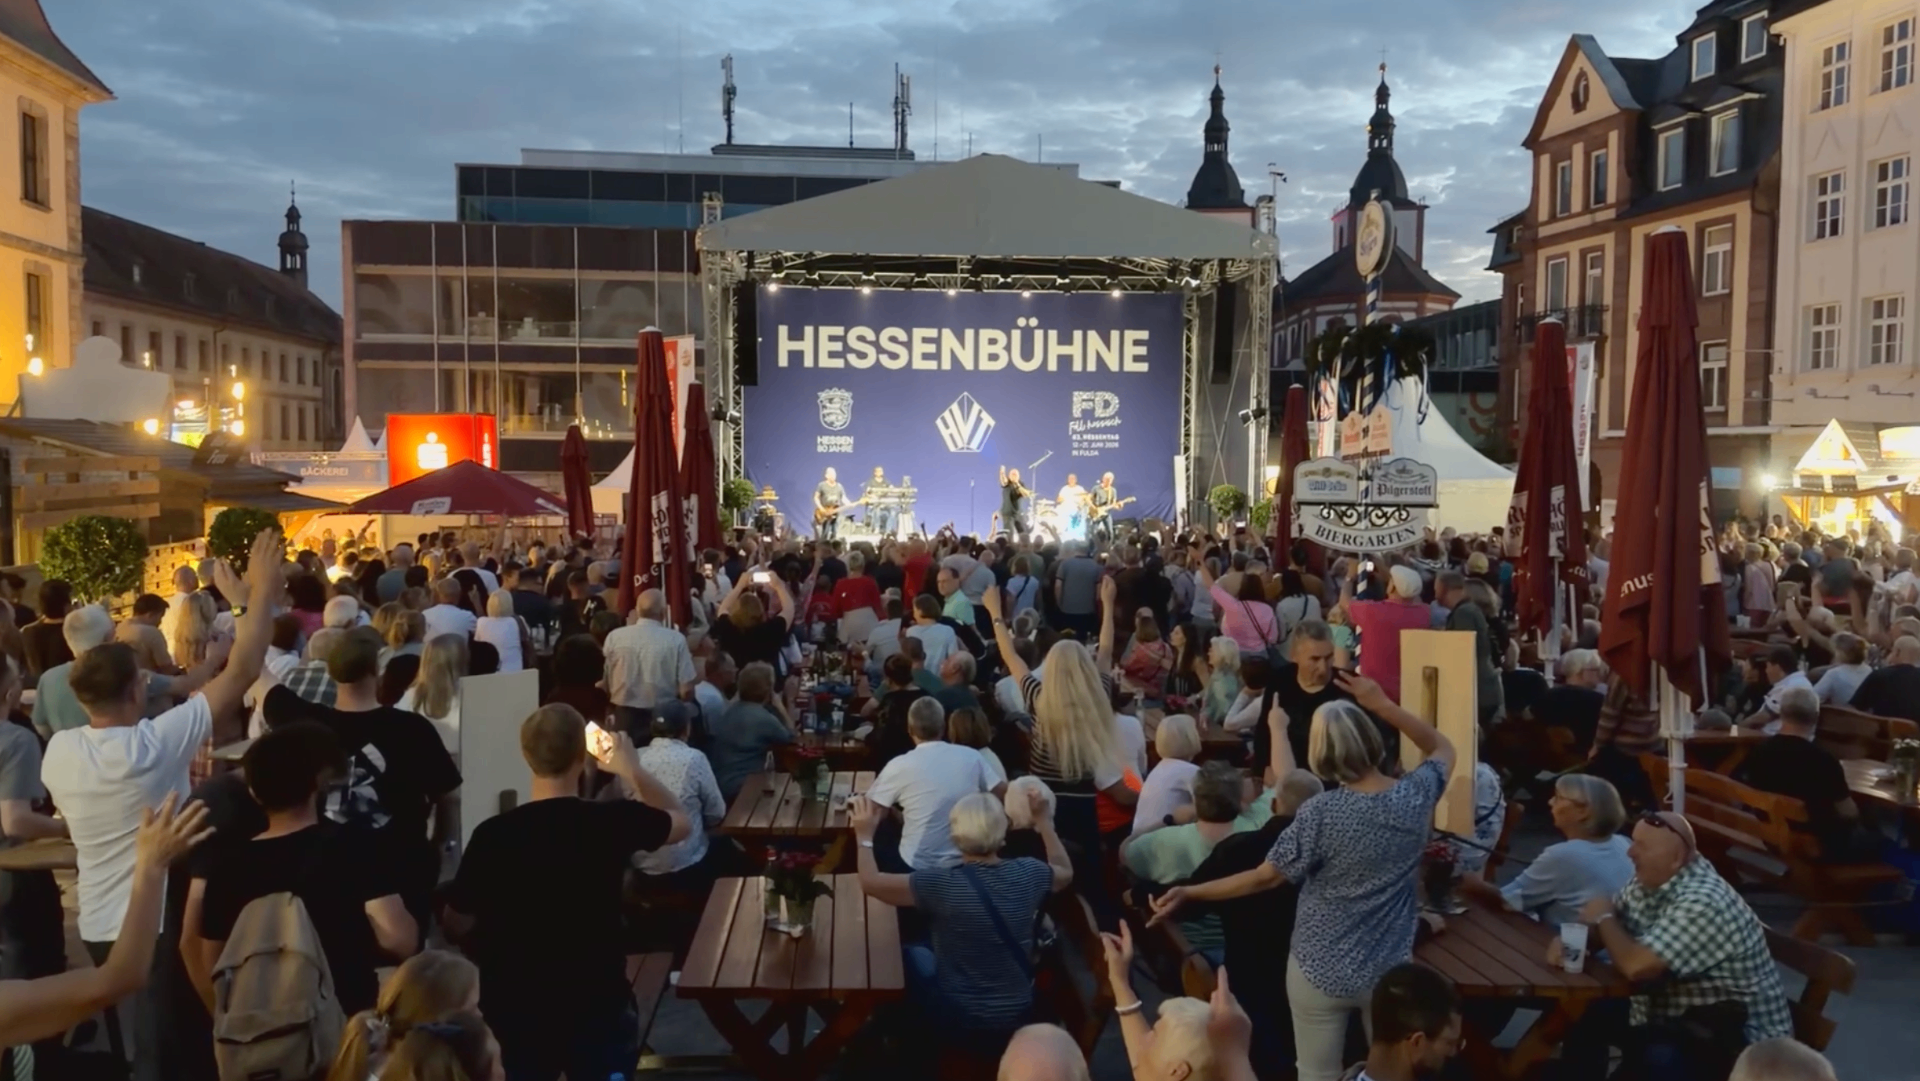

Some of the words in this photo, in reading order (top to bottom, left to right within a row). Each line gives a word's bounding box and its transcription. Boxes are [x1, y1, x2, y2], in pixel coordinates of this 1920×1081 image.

[777, 316, 1150, 373] HESSENBÜHNE
[1073, 391, 1120, 418] FD
[817, 435, 854, 445] HESSEN
[828, 444, 854, 453] JAHRE
[1080, 449, 1099, 457] FULDA
[300, 466, 349, 476] BÄCKEREI
[1376, 483, 1432, 497] Pilgerstoff
[1314, 523, 1418, 548] BIERGARTEN
